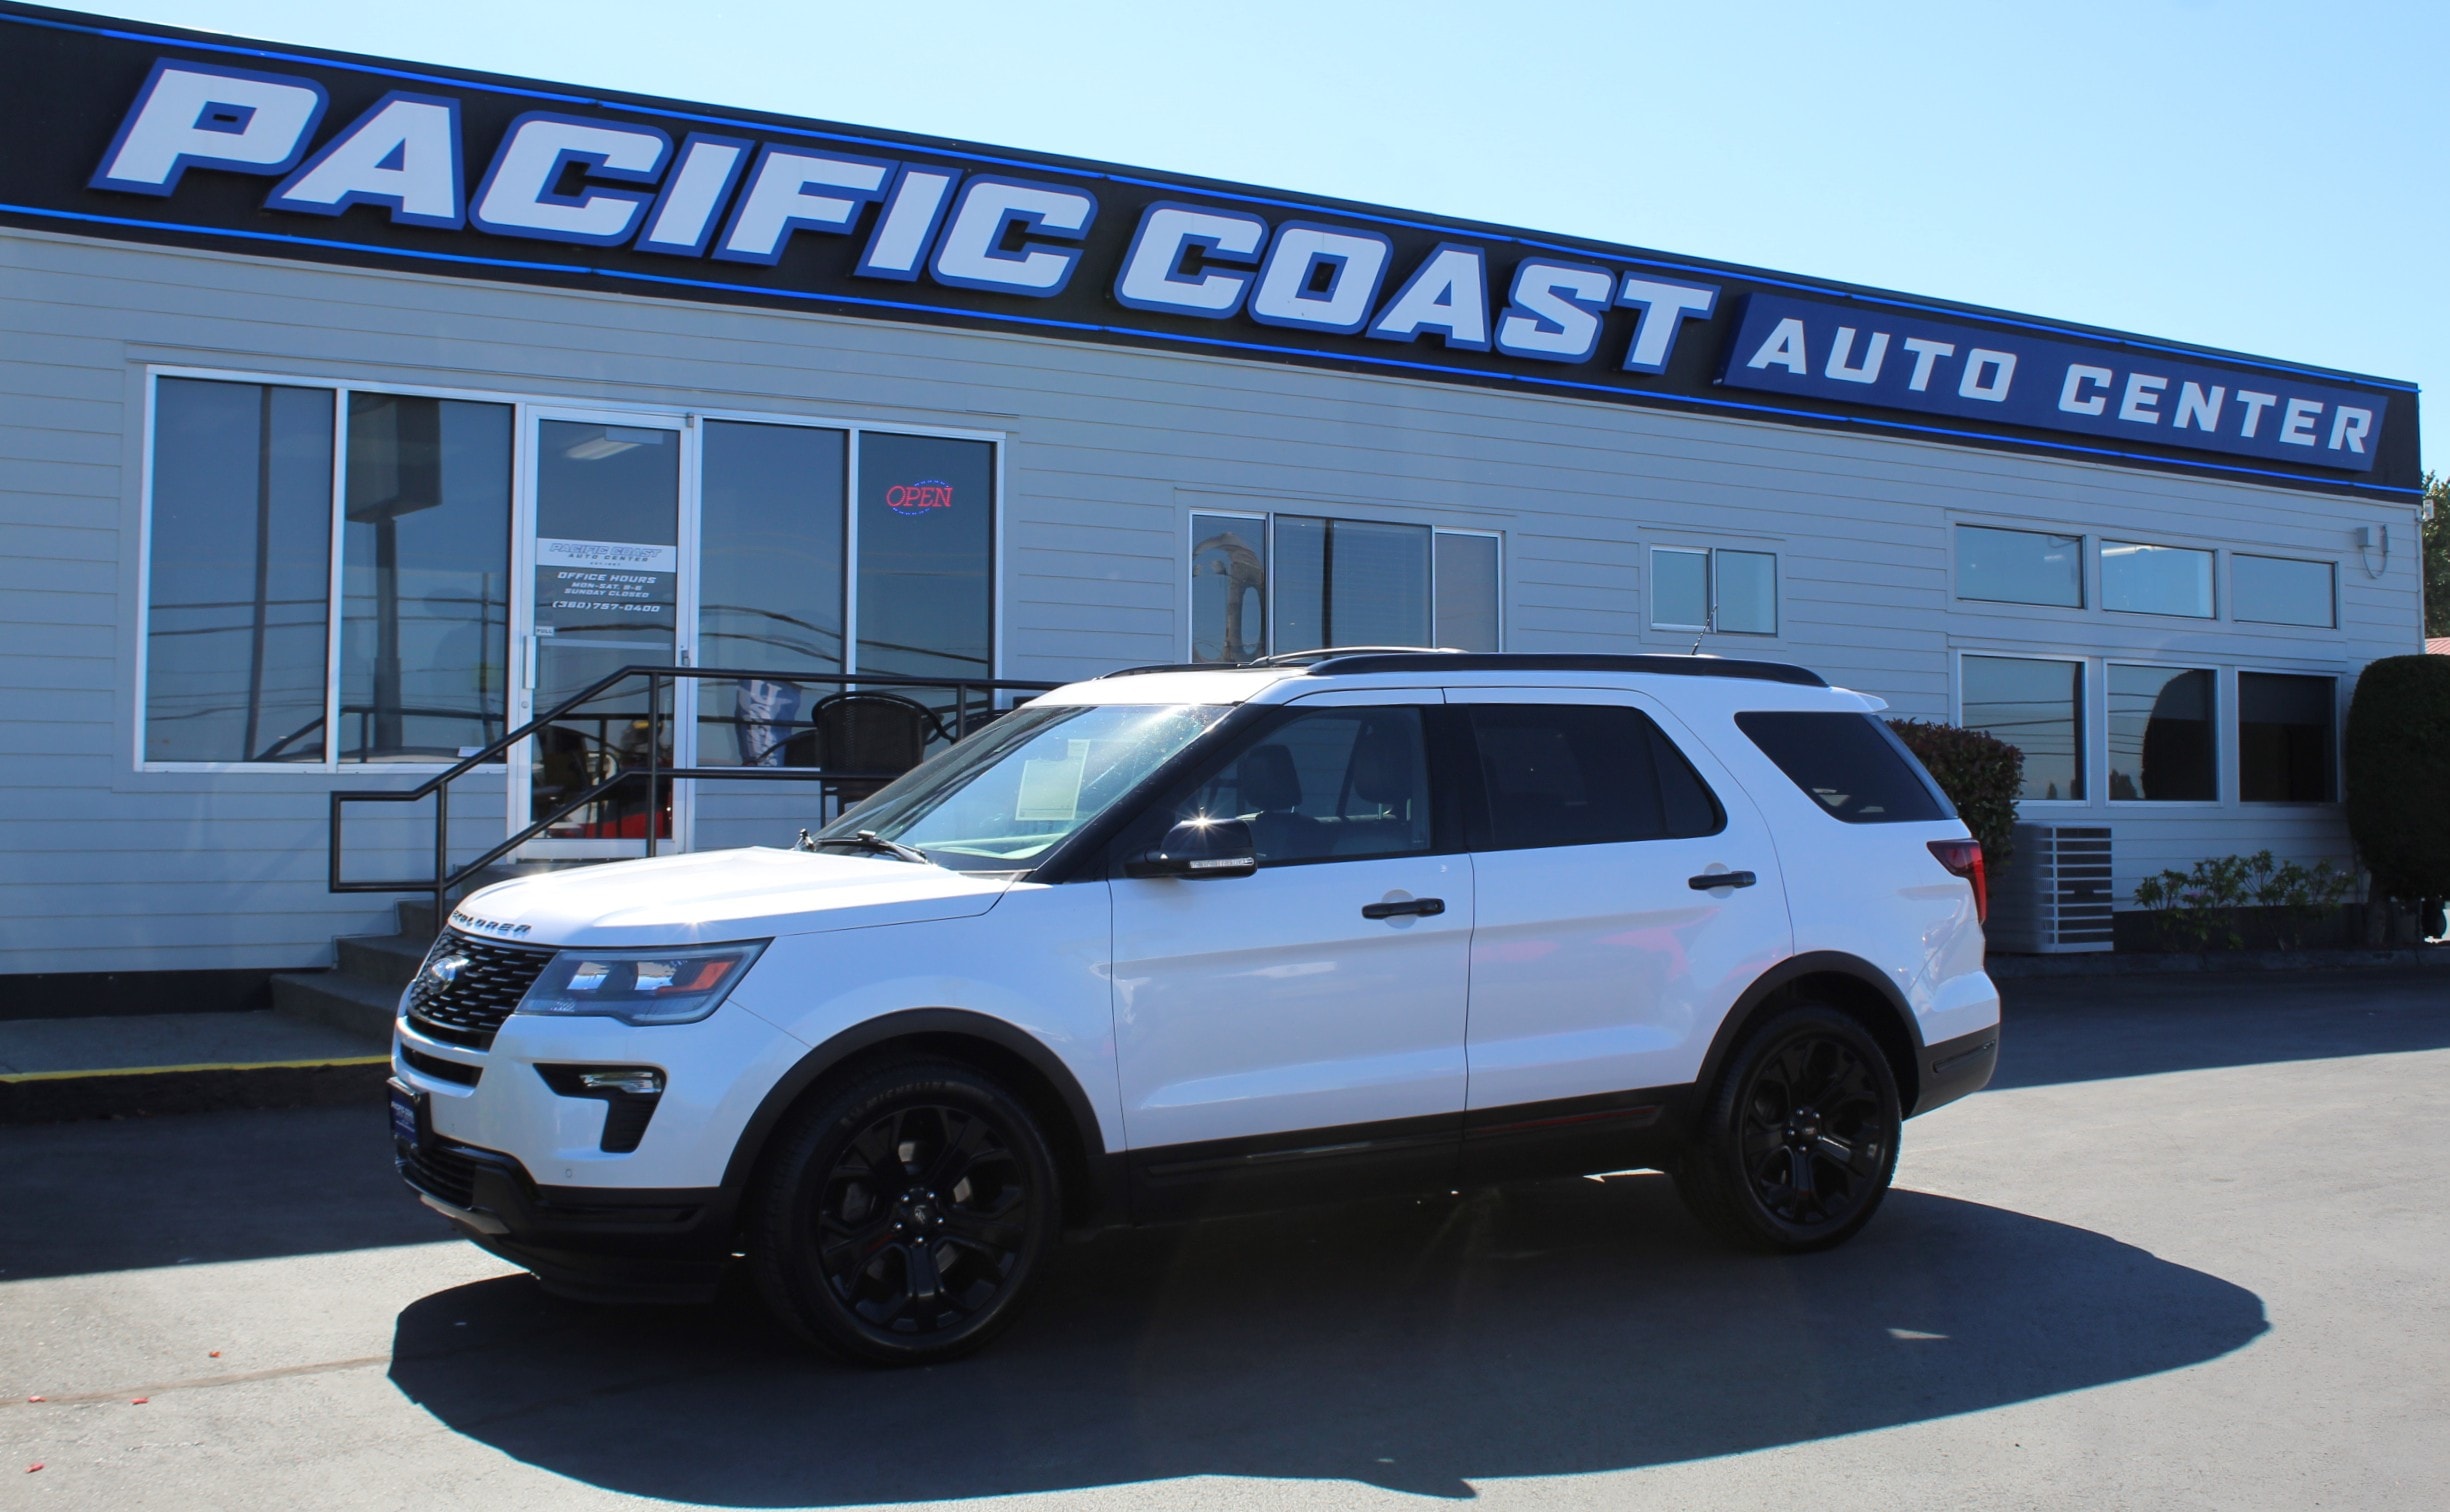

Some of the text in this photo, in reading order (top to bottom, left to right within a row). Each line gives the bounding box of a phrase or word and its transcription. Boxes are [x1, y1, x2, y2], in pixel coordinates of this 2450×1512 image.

[89, 57, 1721, 374] PACIFIC COAST
[1747, 318, 2373, 454] AUTO CENTER
[886, 485, 953, 507] OPEN
[550, 543, 662, 558] PACIFIC COAST
[557, 571, 657, 584] OFFICE HOURS
[564, 588, 650, 598] SUNDAY CLOSED
